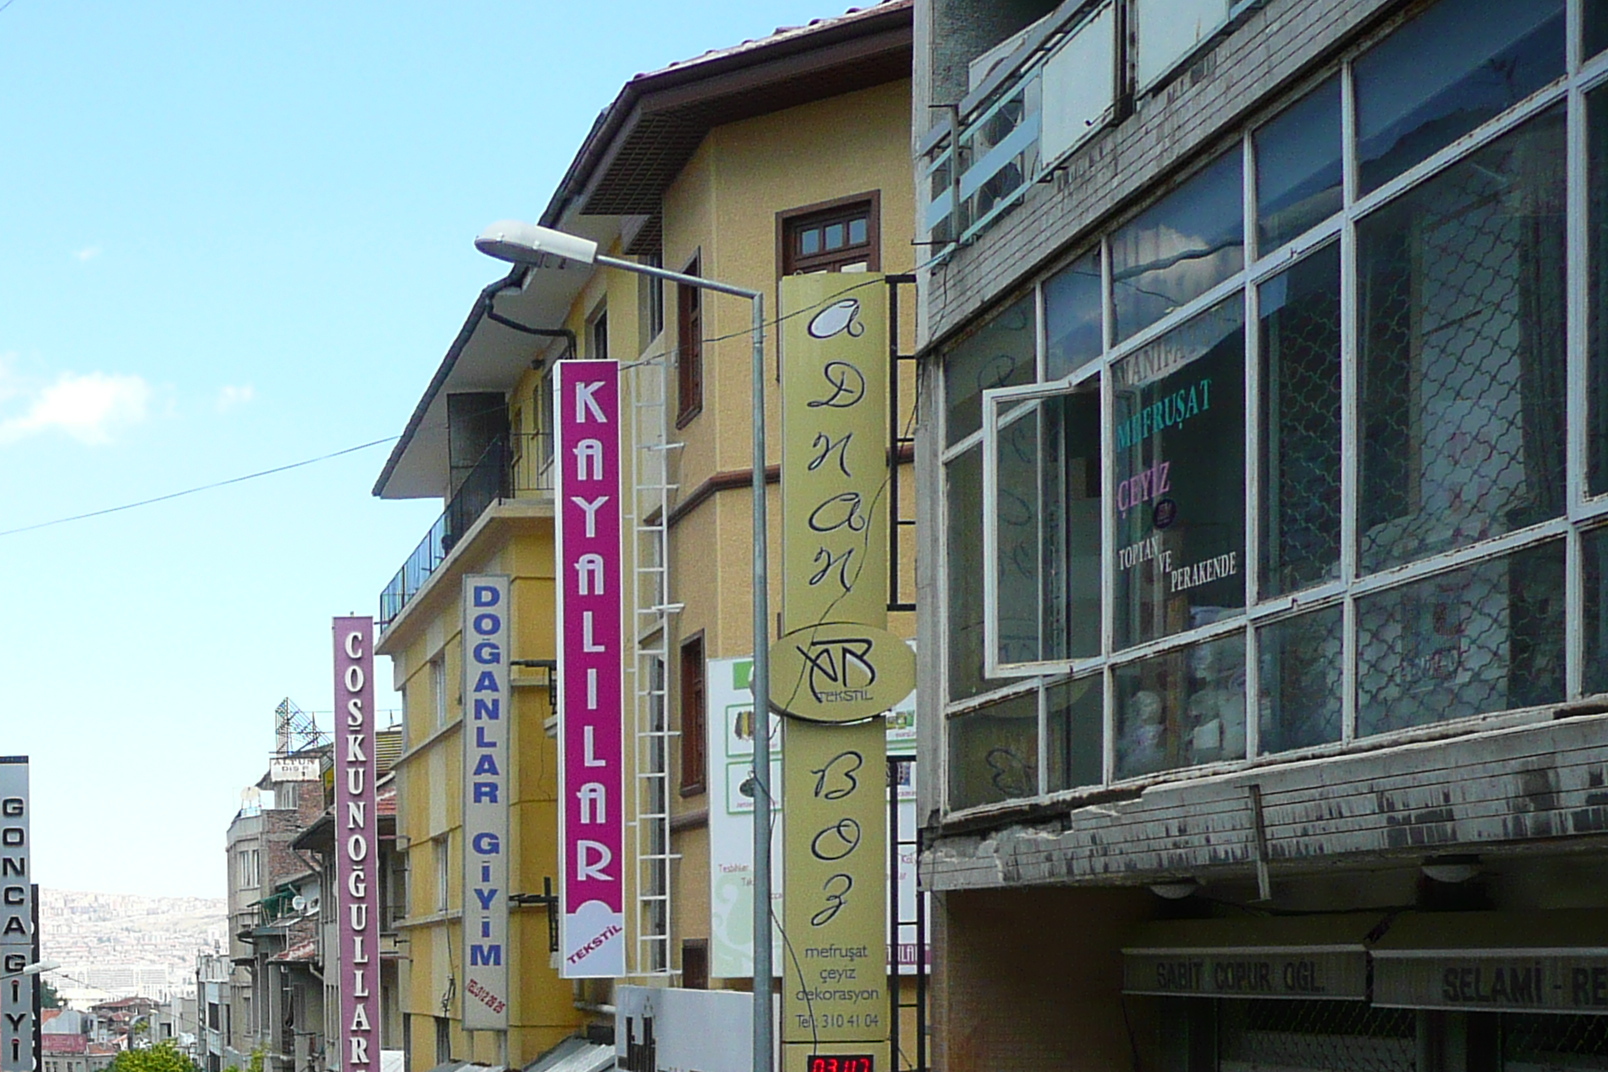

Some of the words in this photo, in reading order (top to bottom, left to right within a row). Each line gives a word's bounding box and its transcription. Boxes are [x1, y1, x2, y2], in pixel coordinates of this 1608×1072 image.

[1117, 377, 1212, 453] MEFRUŞAT
[1119, 535, 1159, 571] TOPTAN
[1158, 550, 1173, 574] VE
[1171, 551, 1237, 592] PERAKENDE
[570, 381, 615, 881] KAYALILAR
[473, 585, 502, 804] DOĞANLAR
[2, 797, 26, 935] GONCA
[470, 832, 502, 967] GİYİM
[567, 925, 623, 964] TEKSTİL
[805, 943, 869, 961] mefruşat
[796, 987, 879, 1005] dekorasyon
[822, 1014, 844, 1028] 310
[847, 1014, 860, 1028] 41
[864, 1014, 879, 1028] 04
